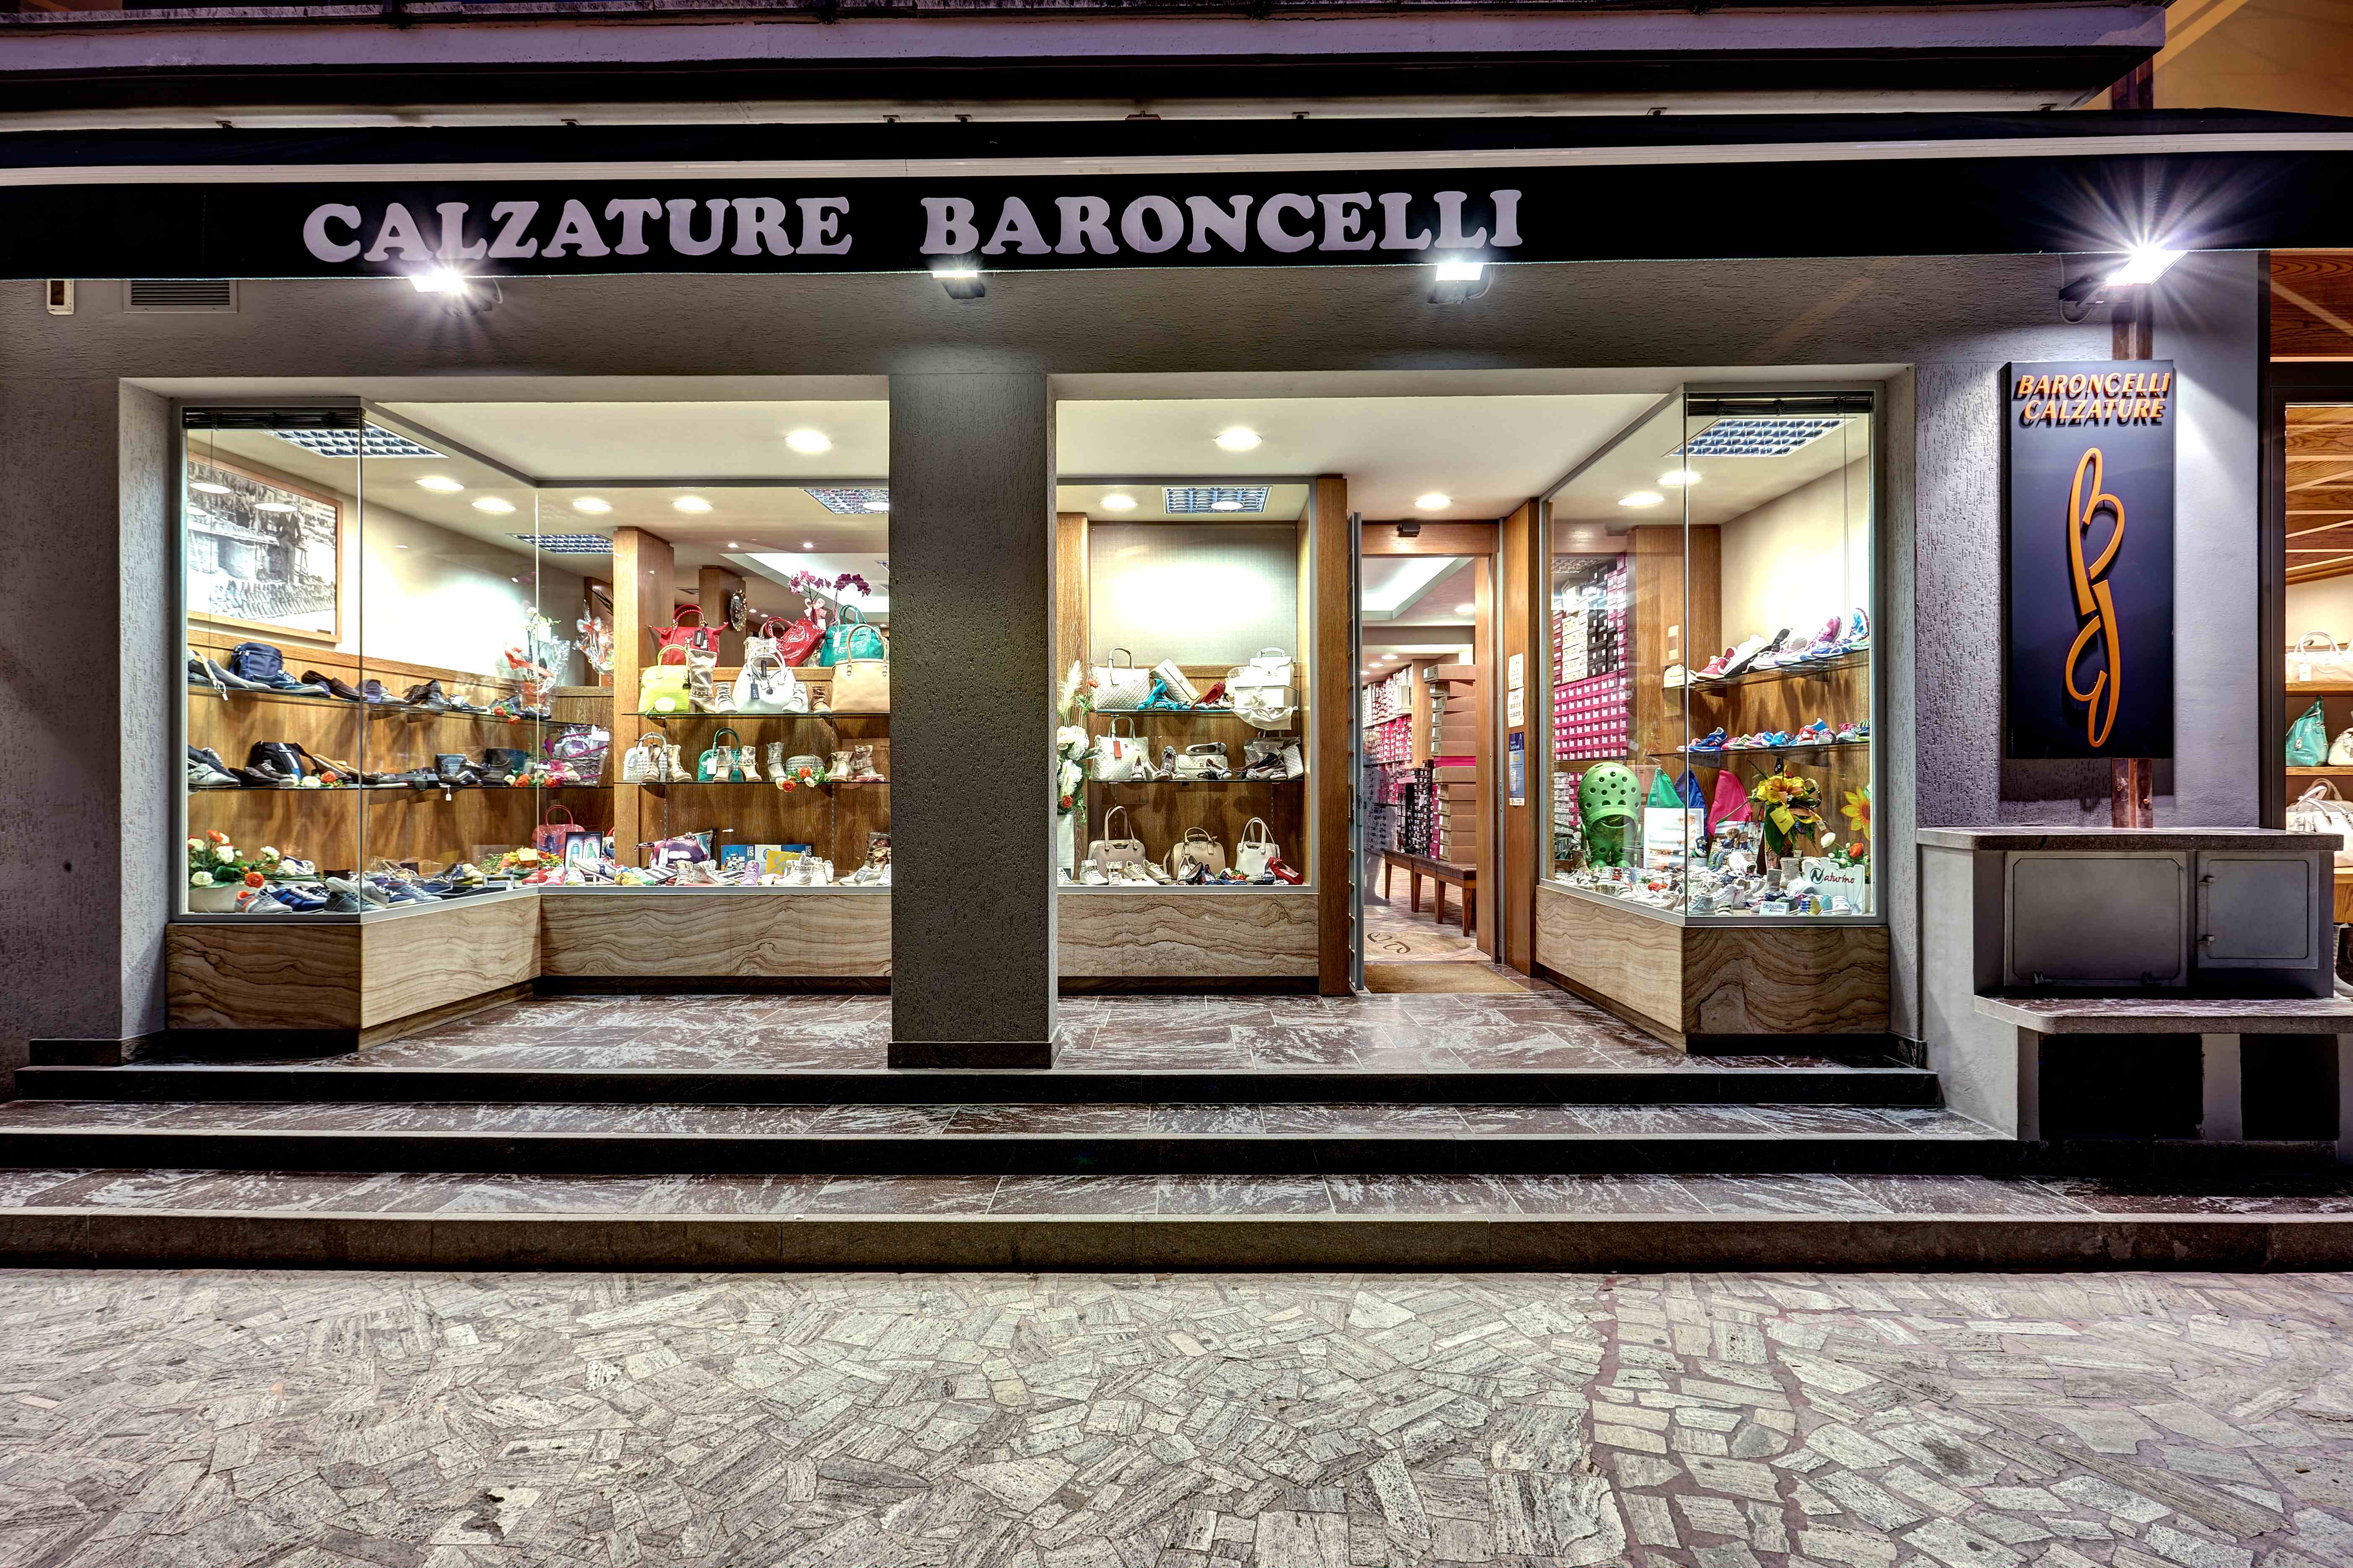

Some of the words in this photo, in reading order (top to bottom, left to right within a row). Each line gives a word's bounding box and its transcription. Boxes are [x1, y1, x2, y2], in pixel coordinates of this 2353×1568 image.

[304, 197, 852, 262] CALZATURE
[920, 189, 1523, 254] BARONCELLI
[2018, 372, 2171, 394] BARONCELLI
[2024, 399, 2166, 420] CALZATURE
[1810, 868, 1856, 884] Naturino
